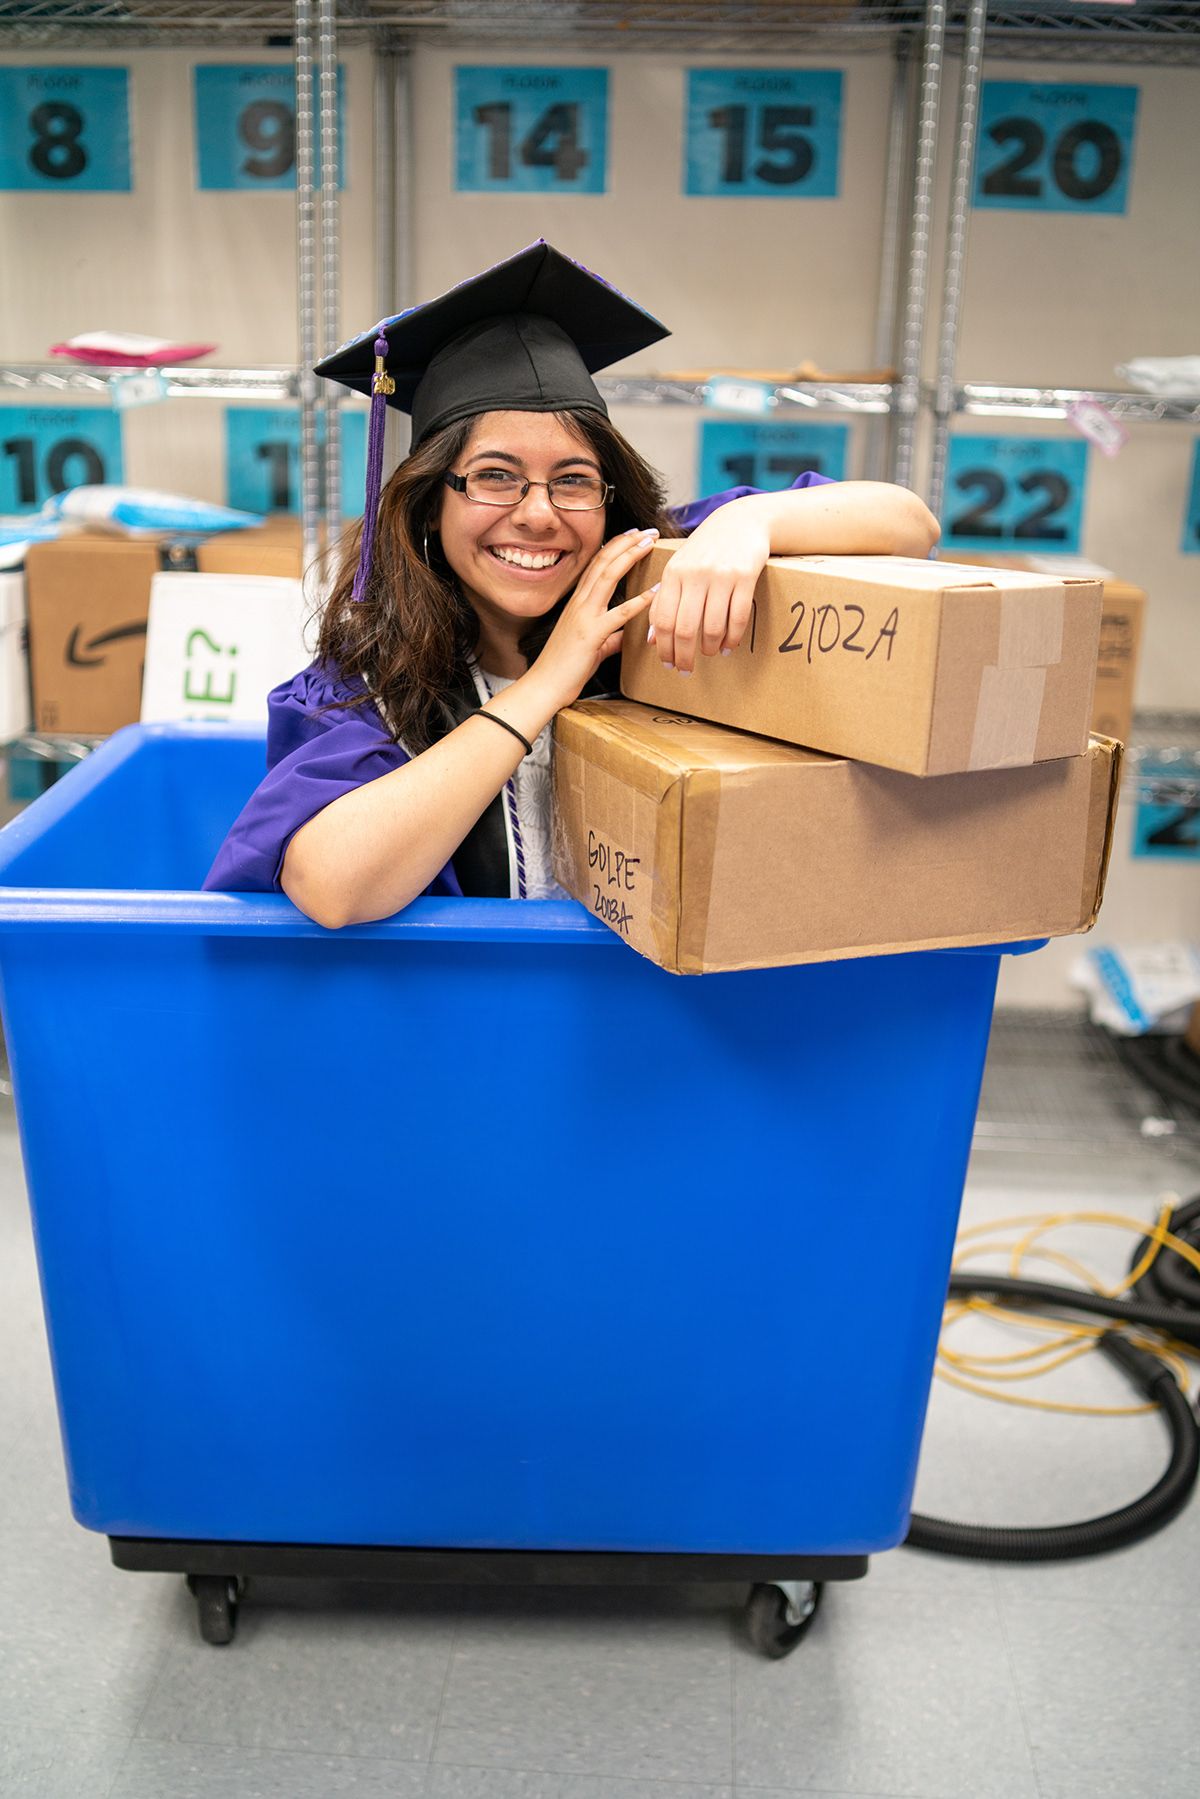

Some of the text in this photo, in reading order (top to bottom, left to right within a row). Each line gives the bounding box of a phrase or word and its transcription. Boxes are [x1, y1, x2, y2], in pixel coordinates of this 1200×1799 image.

[28, 100, 87, 178] 8
[237, 99, 296, 177] 9
[473, 102, 589, 181] 14
[707, 105, 816, 184] 15
[981, 117, 1123, 202] 20
[3, 436, 106, 505] 10
[950, 470, 1072, 540] 22
[778, 600, 899, 664] 2102A
[182, 627, 240, 722] E?
[588, 830, 641, 891] GOLPE
